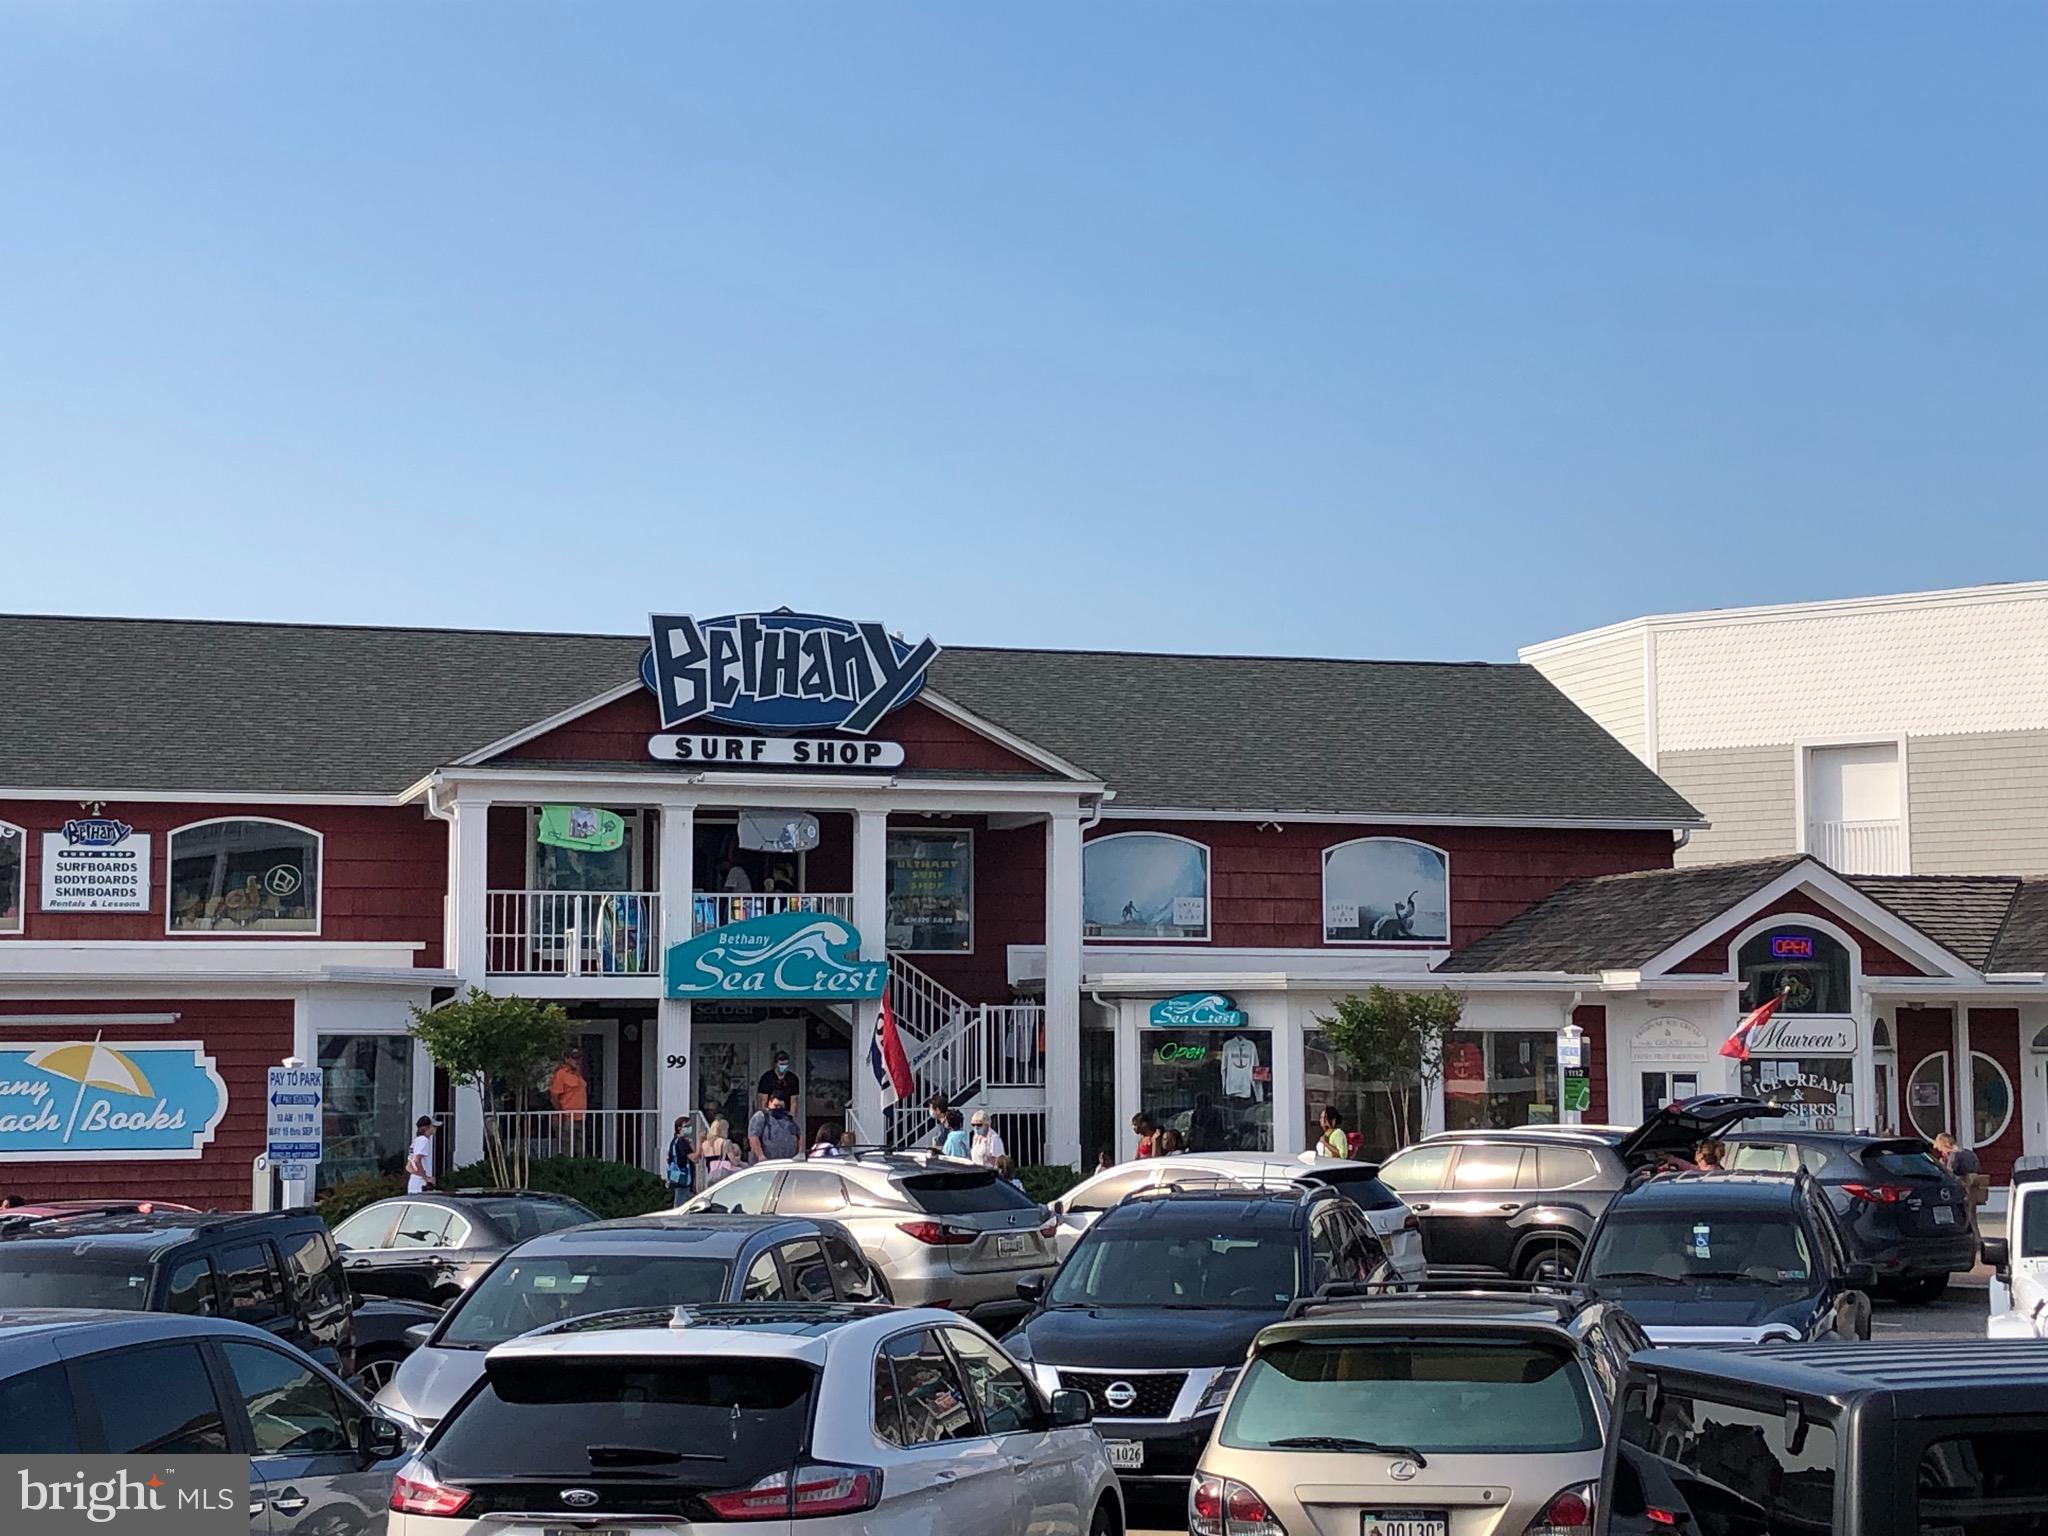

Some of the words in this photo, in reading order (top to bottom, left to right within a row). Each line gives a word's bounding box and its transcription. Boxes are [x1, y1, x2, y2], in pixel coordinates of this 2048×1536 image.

[675, 737, 766, 760] SURF
[793, 741, 882, 764] SHOP
[56, 862, 138, 872] SURFBOARDS
[54, 875, 138, 884] BODYBOARDS
[55, 887, 137, 897] SKIMBOARDS
[49, 899, 86, 907] Rentals
[719, 933, 769, 947] Bethany
[1775, 939, 1809, 953] OPEN
[677, 948, 765, 992] Sea
[774, 950, 878, 992] Crest
[1153, 1006, 1189, 1023] Sea
[1192, 1006, 1236, 1023] Crest
[1752, 1020, 1847, 1050] Maureen's
[666, 1054, 687, 1069] 99
[270, 1072, 285, 1086] PAY
[287, 1071, 298, 1086] TO
[300, 1072, 321, 1086] PARK
[1752, 1075, 1781, 1097] ICE
[1785, 1073, 1844, 1095] CREAM
[0, 1080, 49, 1105] any
[1792, 1088, 1804, 1101] &
[0, 1099, 61, 1132] ach
[80, 1098, 186, 1131] Books
